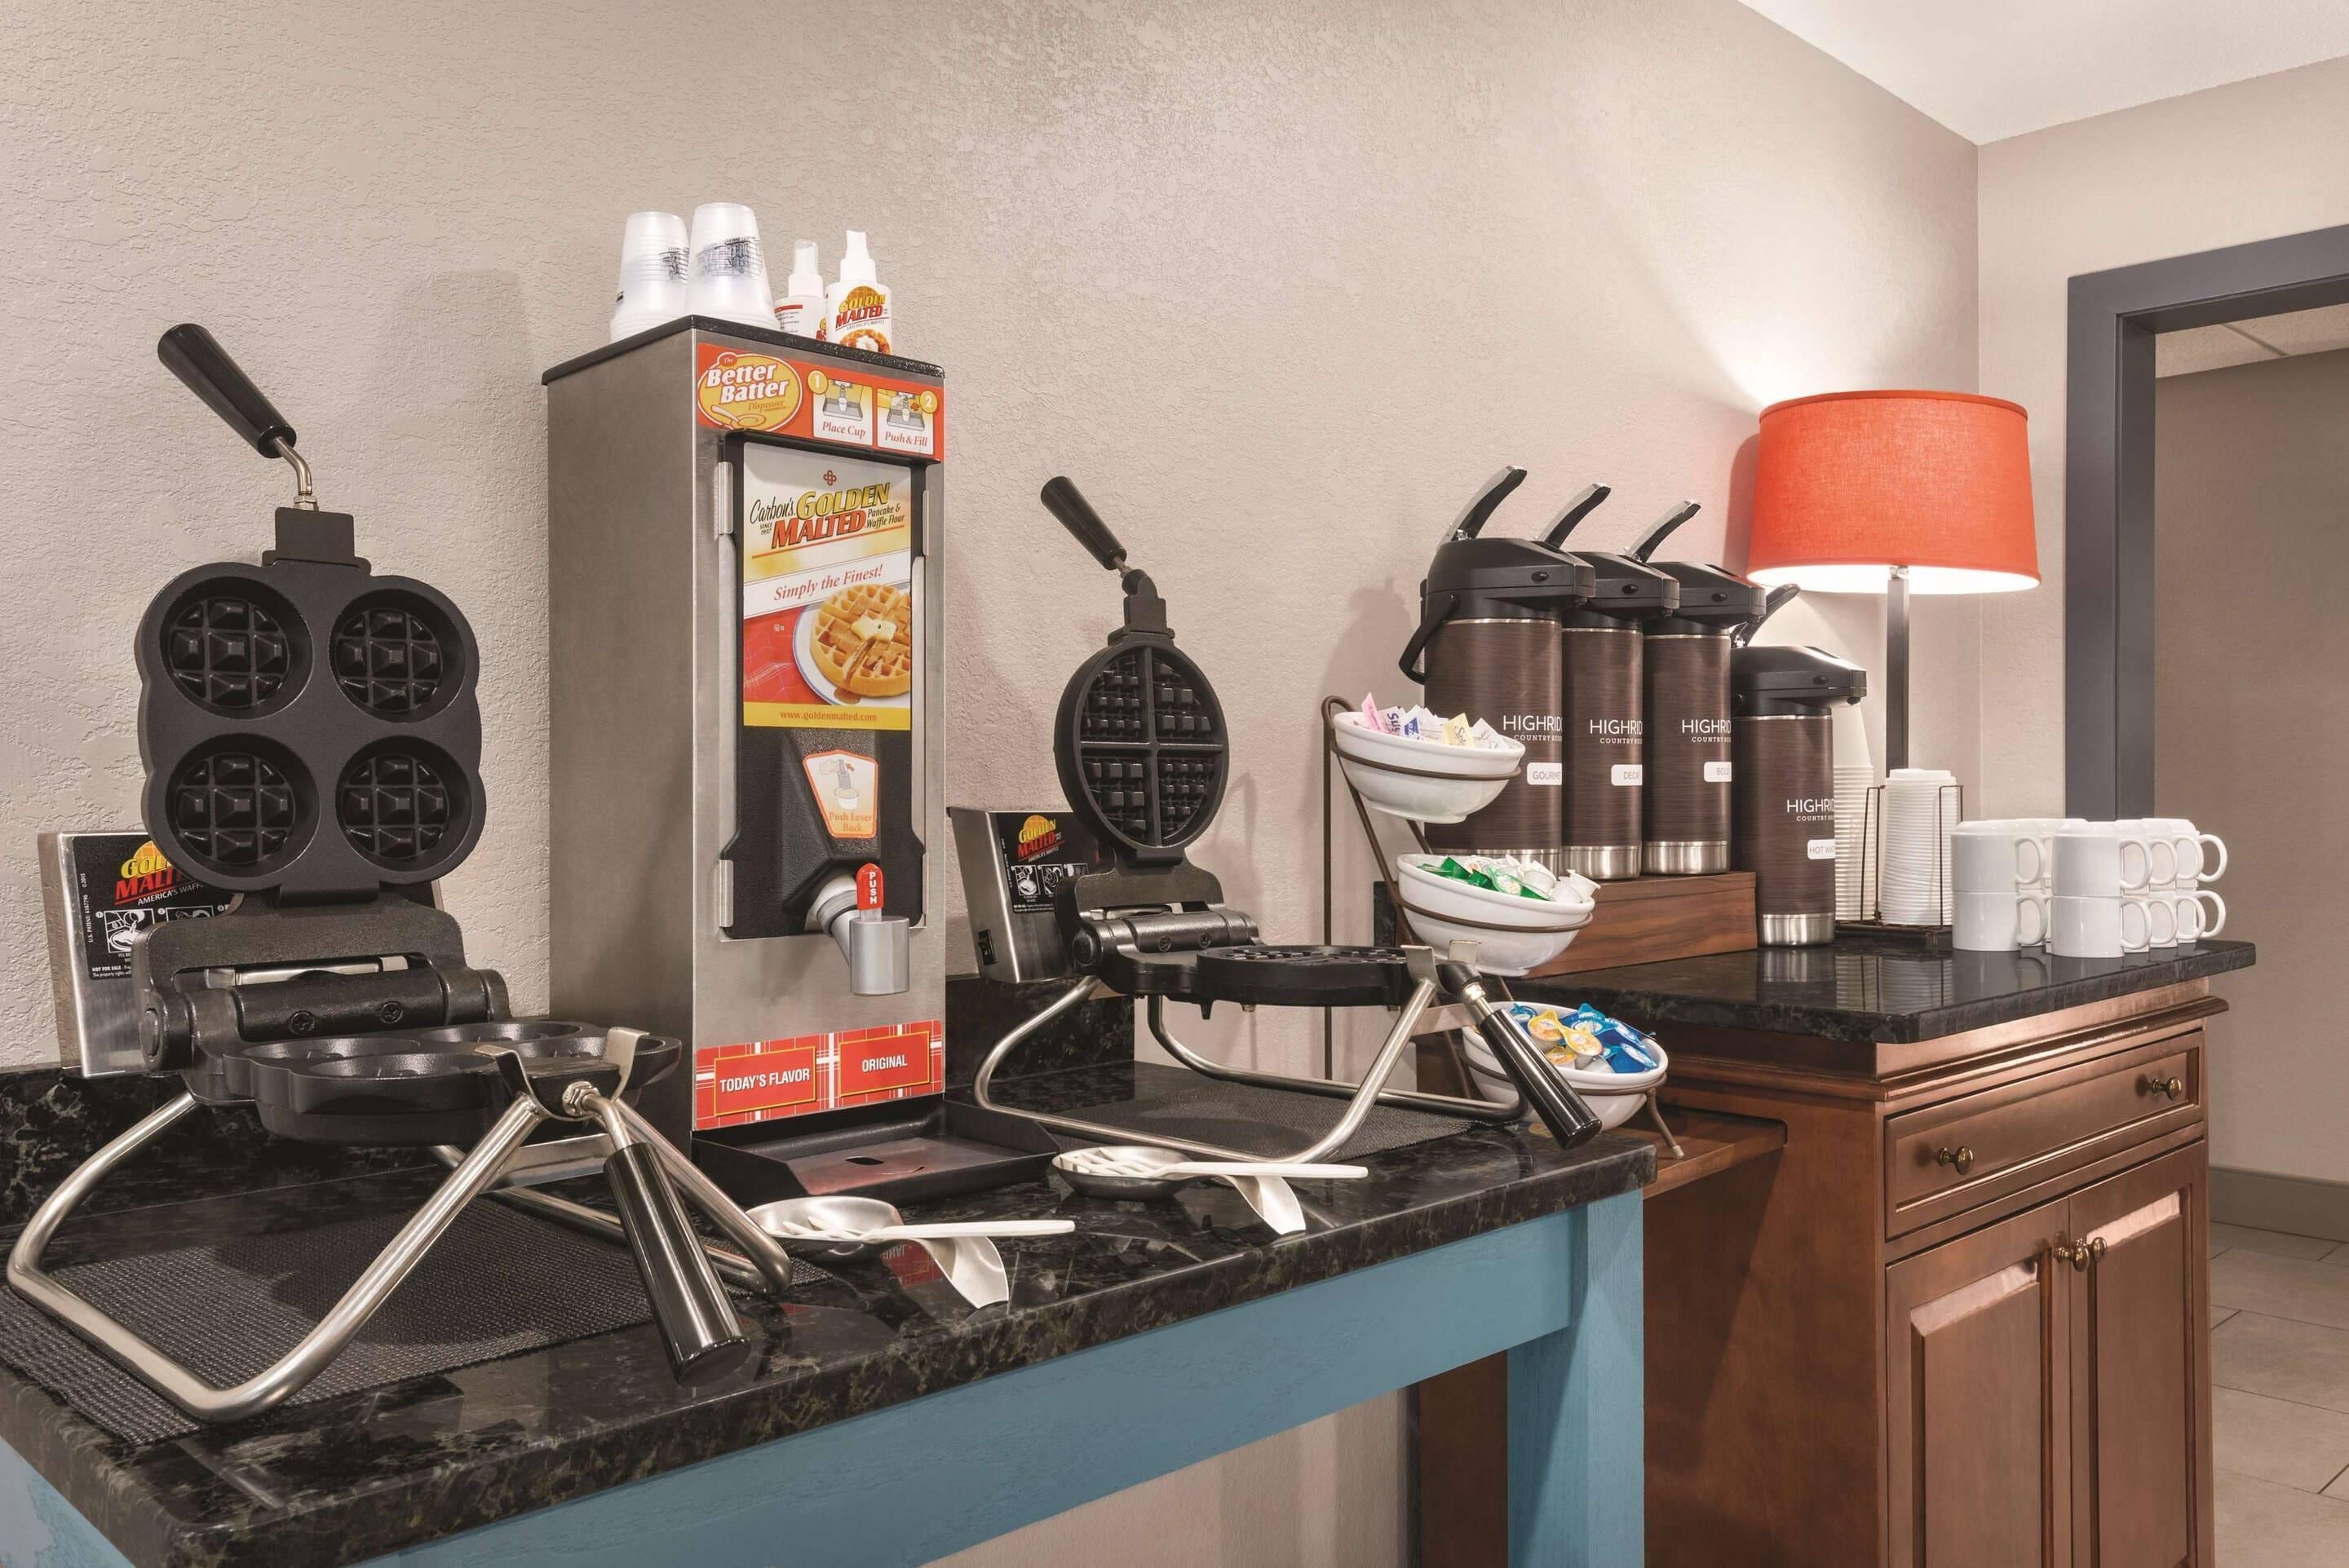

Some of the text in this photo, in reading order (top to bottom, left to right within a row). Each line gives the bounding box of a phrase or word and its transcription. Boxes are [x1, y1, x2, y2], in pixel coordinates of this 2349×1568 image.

[838, 294, 886, 314] GOLDEN
[835, 305, 883, 329] MALTED
[706, 364, 778, 388] Better
[719, 379, 790, 404] Batter
[748, 400, 785, 413] Dispenser
[821, 420, 866, 439] Place Cup
[884, 431, 905, 444] Push
[914, 435, 928, 447] Fill
[796, 482, 890, 521] GOLDEN
[868, 502, 901, 518] Pancake &
[771, 508, 867, 550] MALTED
[867, 514, 905, 529] Waffle Flour
[773, 564, 883, 600] Simply the Finest!
[780, 711, 877, 722] www.goldenmalted.com
[829, 812, 849, 821] Push
[1018, 818, 1056, 844] GOLDEN
[1017, 832, 1055, 858] MALTED
[121, 855, 172, 879] GOL
[137, 887, 178, 906] AMERICA'S
[868, 872, 878, 904] PUSH
[861, 1054, 908, 1072] ORIGINAL
[719, 1067, 811, 1093] TODAY'S FLAVOR
